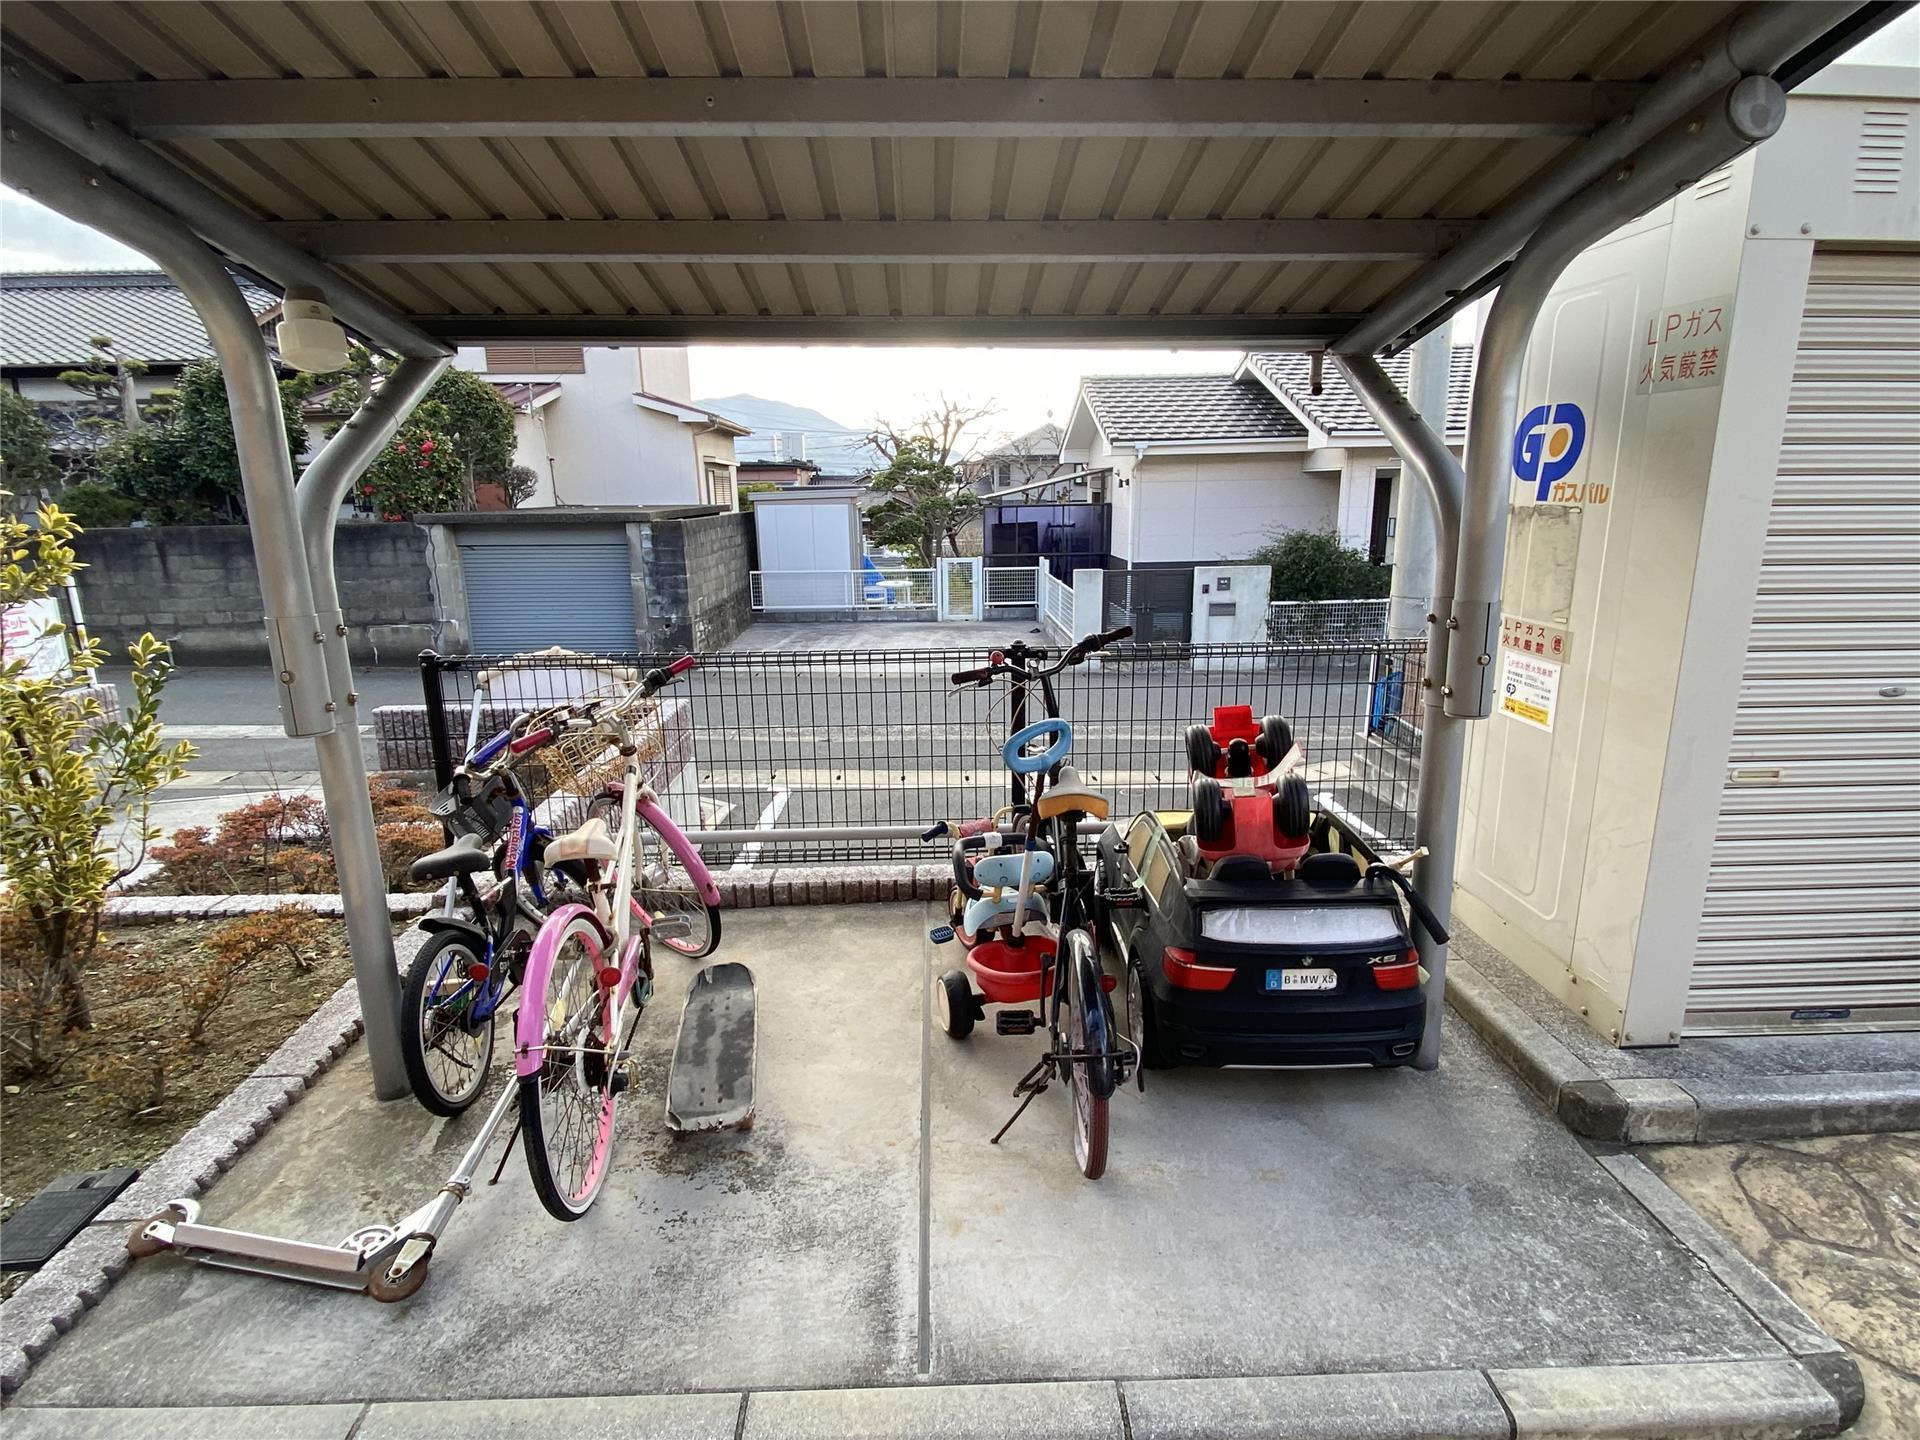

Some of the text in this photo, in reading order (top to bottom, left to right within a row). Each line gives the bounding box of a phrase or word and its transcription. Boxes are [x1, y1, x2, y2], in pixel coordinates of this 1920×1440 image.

[1646, 307, 1723, 346] LPガス
[1639, 346, 1720, 385] 火気厳禁
[1551, 481, 1610, 505] ガスパル
[1505, 619, 1545, 638] LPガス
[1503, 635, 1544, 655] 火気厳禁
[504, 814, 522, 870] Navigator
[1366, 954, 1397, 965] X5
[1300, 975, 1319, 984] MW
[1321, 975, 1334, 984] X5
